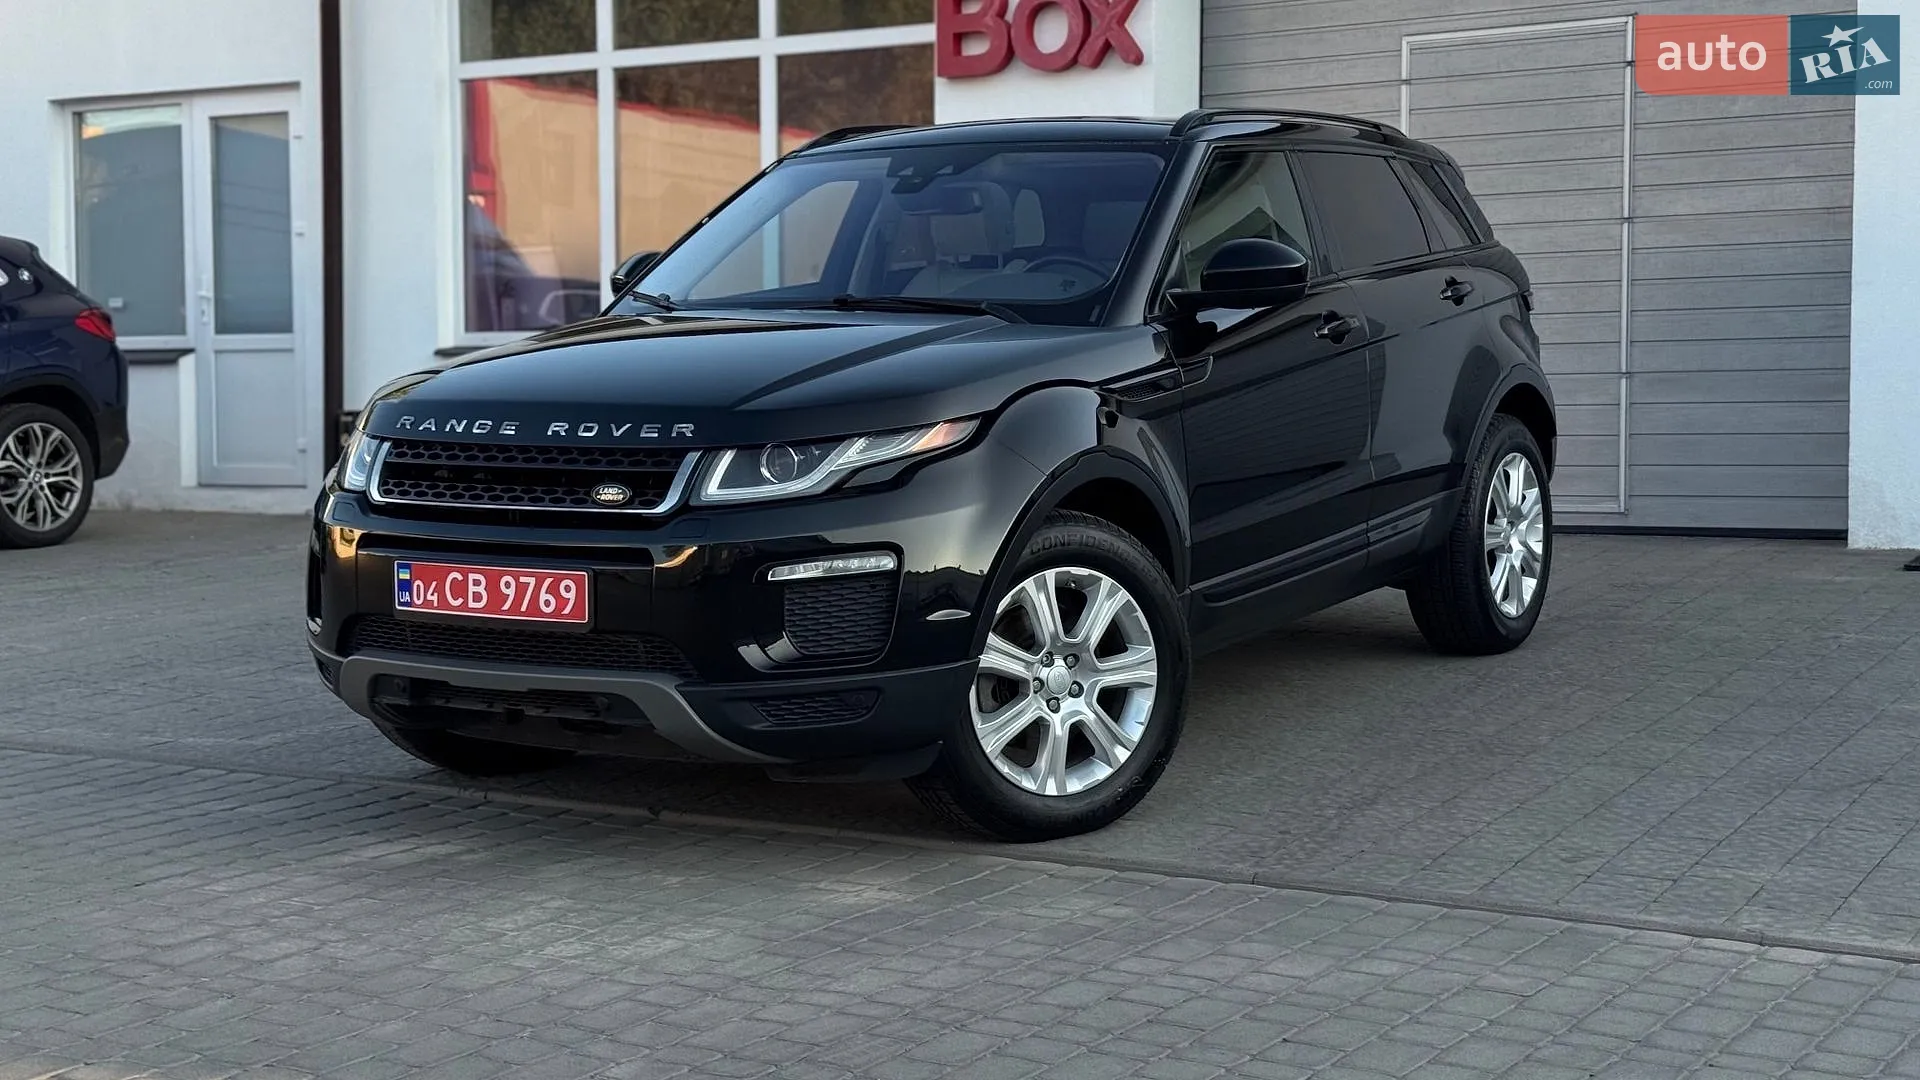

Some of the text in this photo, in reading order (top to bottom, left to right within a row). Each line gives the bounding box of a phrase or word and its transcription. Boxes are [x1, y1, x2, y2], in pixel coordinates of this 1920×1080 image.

[396, 415, 697, 438] RANGE ROVER
[599, 487, 618, 495] LAND
[600, 493, 624, 502] ROVER
[399, 591, 411, 603] UA
[412, 571, 578, 615] 04 CB 9769
